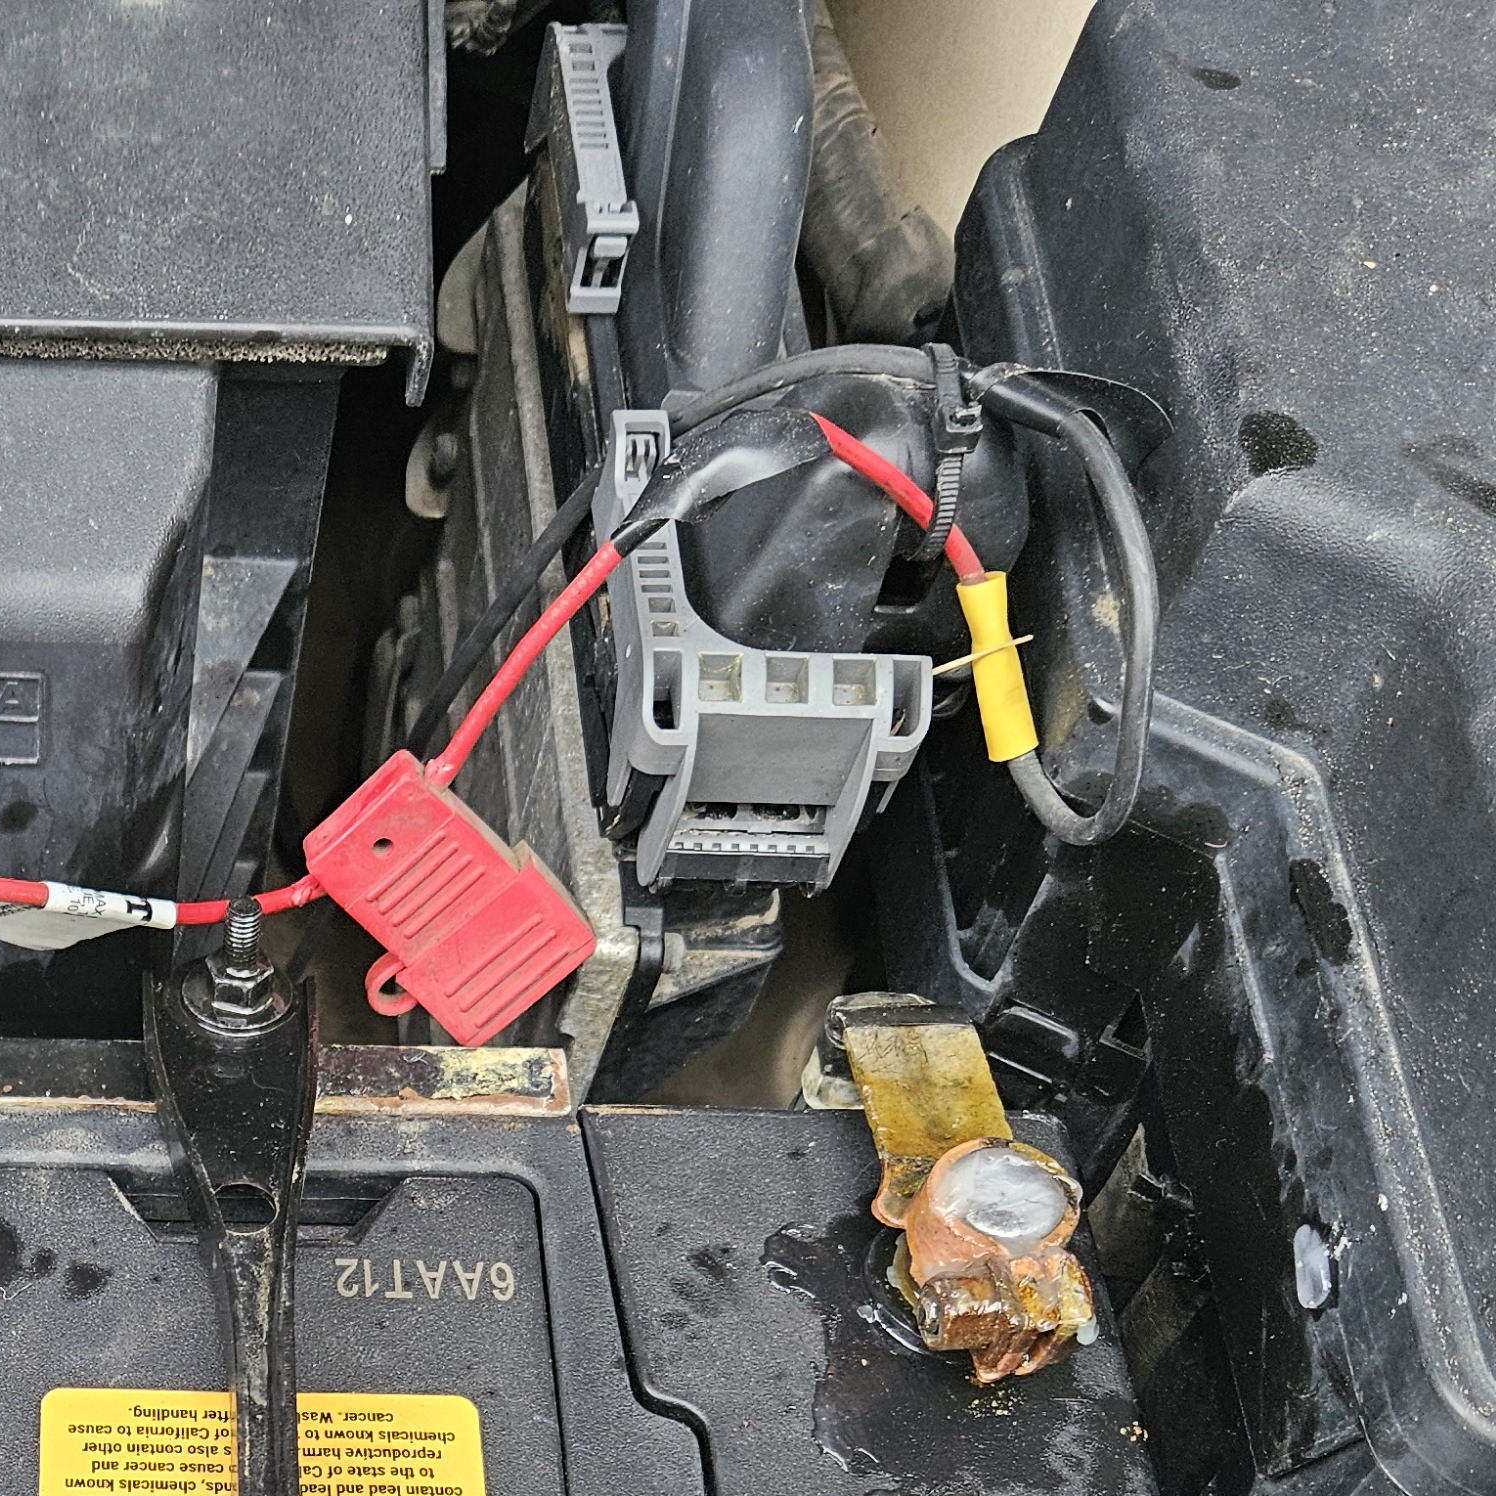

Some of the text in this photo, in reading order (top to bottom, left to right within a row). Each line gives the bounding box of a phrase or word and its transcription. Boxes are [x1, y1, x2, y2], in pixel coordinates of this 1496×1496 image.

[335, 1255, 517, 1301] 6AAT12
[128, 1405, 393, 1422] cancer. handling.
[69, 1425, 455, 1444] chemicals known to of California to cause
[82, 1443, 121, 1455] other
[127, 1443, 182, 1456] contain
[188, 1445, 218, 1458] also
[345, 1447, 441, 1461] reproductive
[92, 1461, 118, 1473] and
[124, 1462, 174, 1471] cancer
[180, 1463, 223, 1473] cause
[328, 1466, 342, 1478] of
[348, 1466, 385, 1477] state
[391, 1467, 414, 1479] the
[420, 1468, 434, 1478] to
[66, 1479, 113, 1492] known
[119, 1480, 196, 1494] chemicals
[337, 1484, 363, 1496] and
